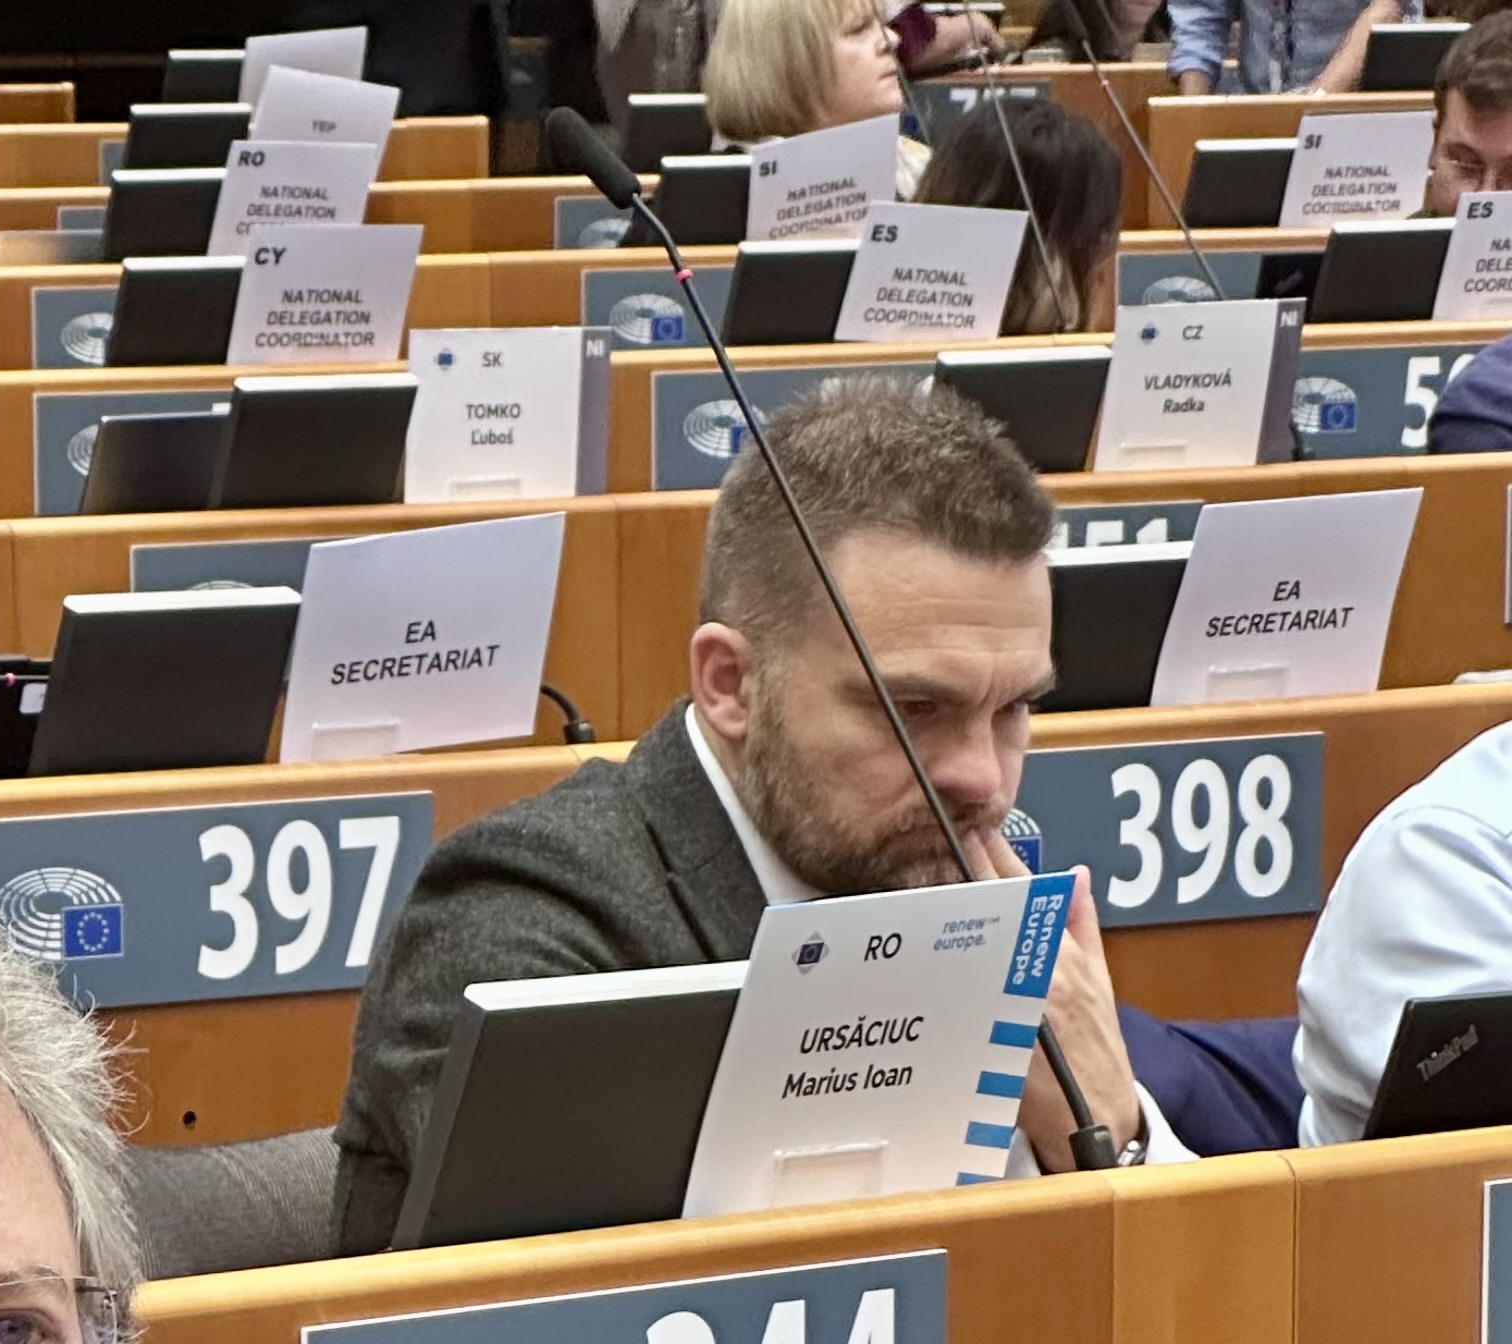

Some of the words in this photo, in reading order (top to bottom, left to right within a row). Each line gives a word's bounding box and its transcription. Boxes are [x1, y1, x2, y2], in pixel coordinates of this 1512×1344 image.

[1303, 134, 1322, 149] SI
[238, 151, 266, 167] RO
[758, 160, 777, 177] SI
[1324, 165, 1391, 179] NATIONAL
[260, 185, 329, 200] NATIONAL
[787, 176, 857, 201] NATIONAL
[1311, 182, 1397, 198] DELEGATION
[246, 203, 336, 219] DELEGATION
[776, 191, 866, 221] DELEGATION
[1466, 201, 1494, 220] ES
[870, 224, 898, 243] ES
[254, 247, 286, 266] CY
[892, 267, 968, 287] NATIONAL
[281, 289, 363, 304] NATIONAL
[876, 286, 974, 308] DELEGATION
[267, 310, 371, 326] DELEGATION
[863, 307, 976, 329] COORDINATOR
[1280, 311, 1299, 327] NI
[255, 332, 375, 348] COORDINATOR
[1182, 324, 1204, 341] CZ
[586, 339, 605, 358] NI
[482, 351, 503, 367] SK
[1144, 367, 1233, 391] VLADYKOVÁ
[465, 403, 522, 419] TOMKO
[1162, 398, 1205, 415] Radka
[1272, 579, 1301, 602] EA
[405, 619, 437, 644] EA
[1205, 606, 1354, 638] SECRETARIAT
[330, 644, 501, 685] SECRETARIAT
[1106, 754, 1293, 908] 398
[197, 815, 400, 980] 397
[942, 918, 986, 934] renew
[1031, 894, 1065, 977] Renew
[863, 932, 903, 962] RO
[1012, 896, 1048, 985] Europe
[799, 1015, 925, 1054] URSĂCIUC
[782, 1068, 857, 1099] Marius
[863, 1063, 913, 1090] Ioan
